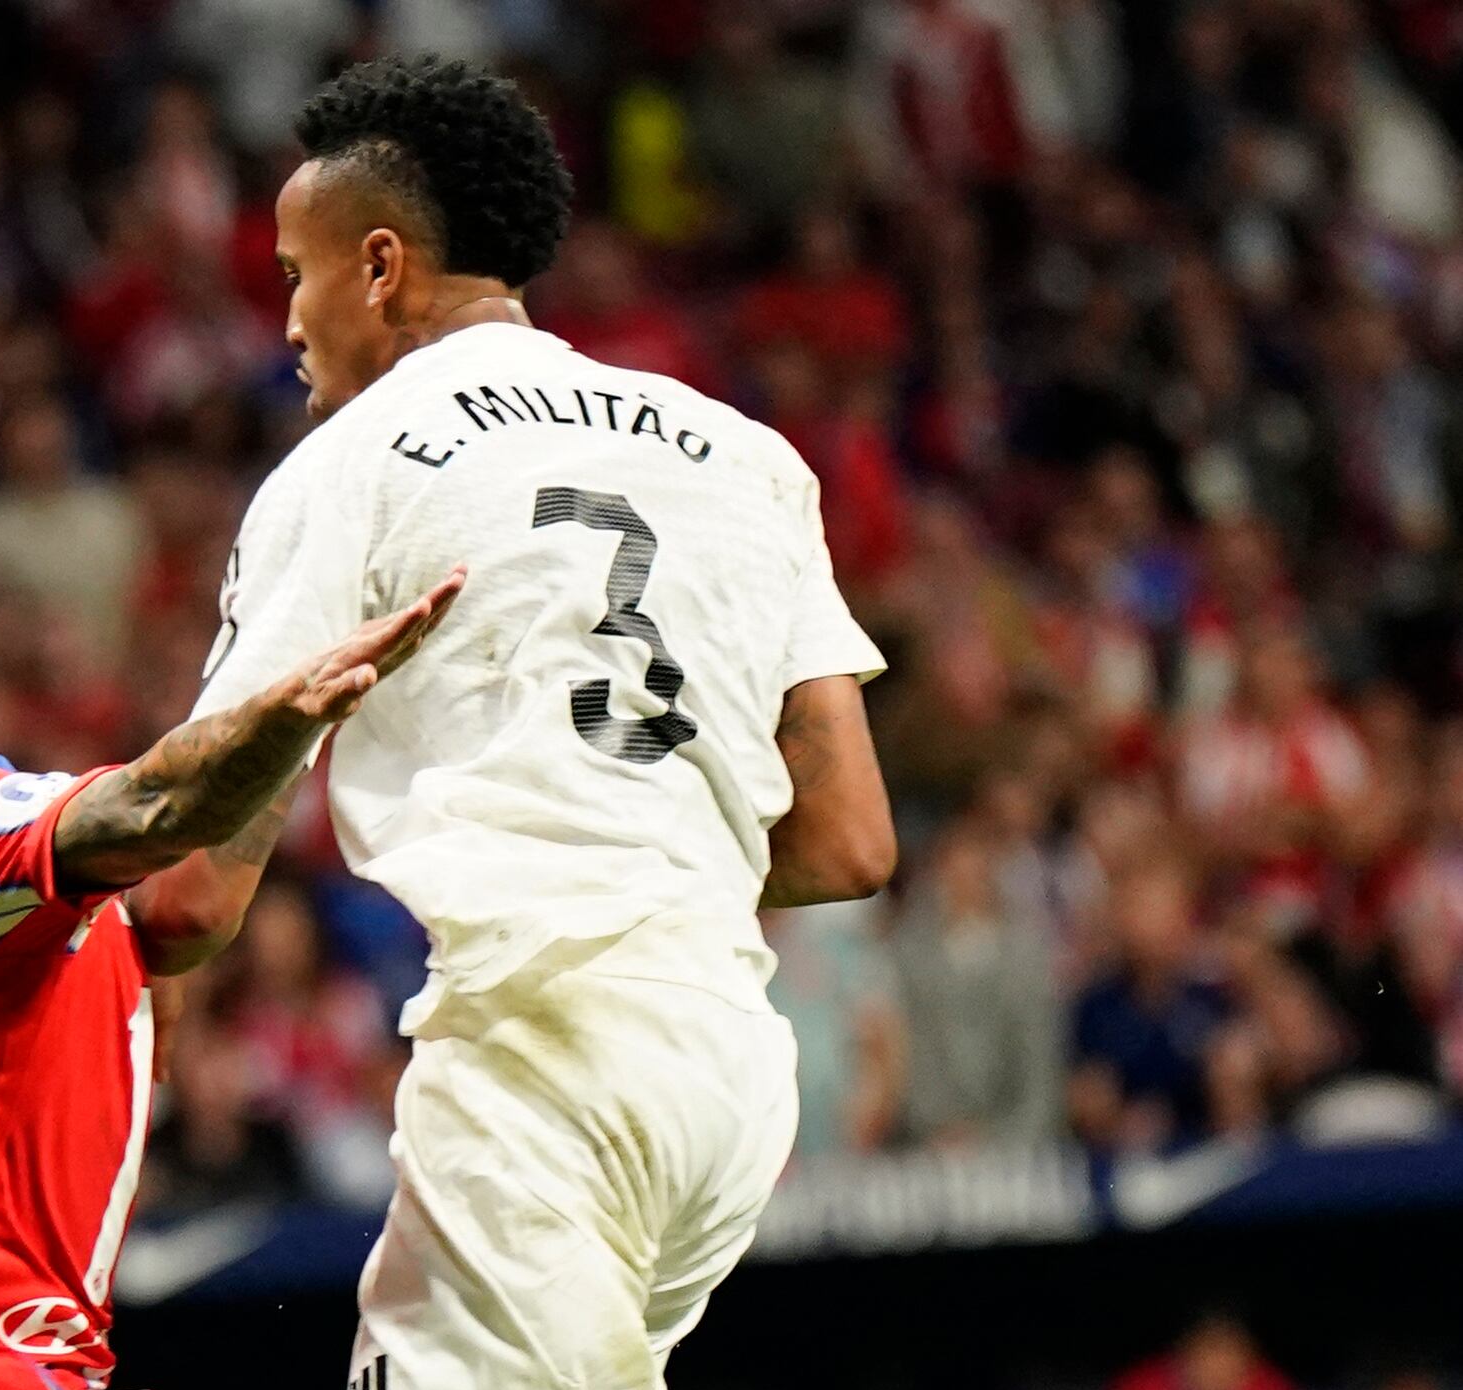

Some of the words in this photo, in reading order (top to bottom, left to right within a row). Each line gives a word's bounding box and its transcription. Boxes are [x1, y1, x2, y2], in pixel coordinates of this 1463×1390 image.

[391, 431, 467, 468] E.
[453, 385, 712, 463] MILITÃO
[532, 486, 697, 765] 3
